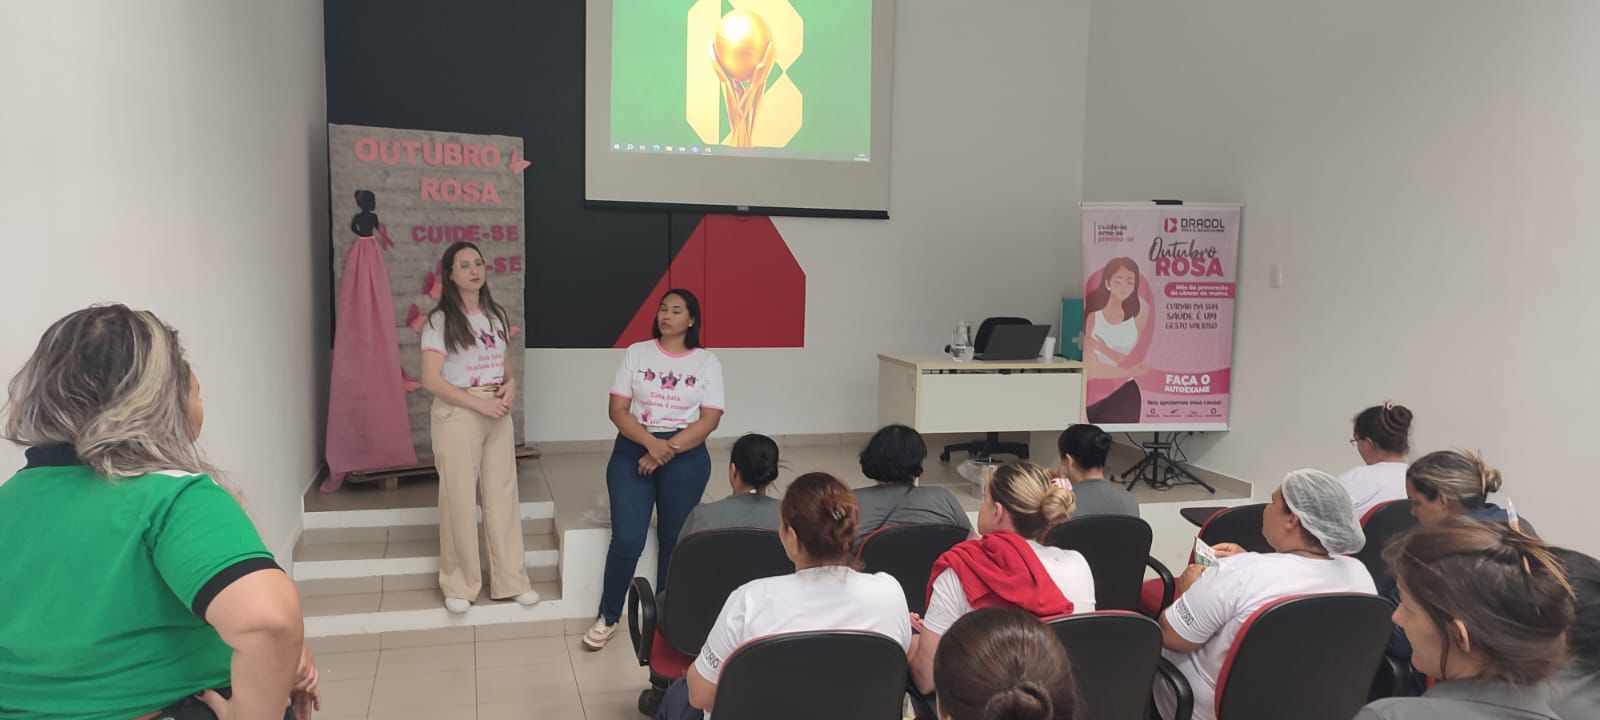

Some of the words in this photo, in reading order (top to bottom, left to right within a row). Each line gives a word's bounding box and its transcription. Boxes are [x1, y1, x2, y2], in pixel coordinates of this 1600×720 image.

[354, 138, 501, 168] OUTUBRO
[419, 177, 501, 204] ROSA
[412, 224, 519, 245] CUIDE-SE
[1148, 236, 1217, 261] Outubro
[1155, 257, 1224, 277] ROSA
[1166, 311, 1192, 320] SAÚDE
[1196, 311, 1202, 320] É
[1204, 312, 1217, 320] UM
[1189, 322, 1218, 330] VALIOSO
[1165, 374, 1198, 386] FAÇA
[1201, 374, 1211, 385] O
